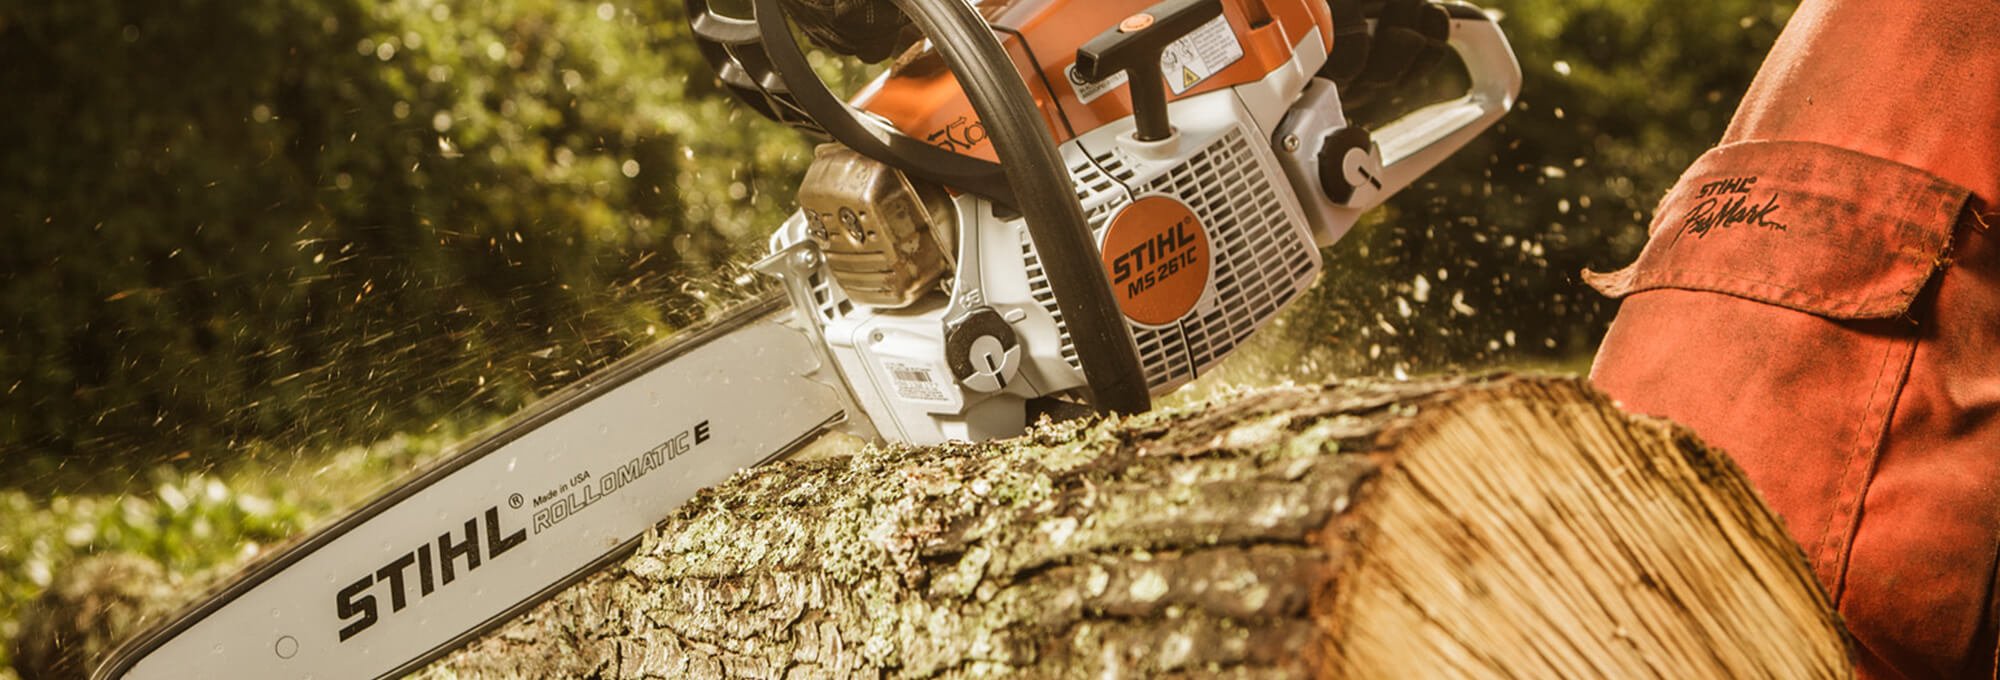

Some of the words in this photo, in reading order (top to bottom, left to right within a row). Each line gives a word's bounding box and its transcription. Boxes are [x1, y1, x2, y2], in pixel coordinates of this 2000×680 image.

[1128, 270, 1156, 299] MS
[532, 430, 690, 534] ROLLOMATIC
[694, 420, 711, 446] E
[532, 489, 558, 507] Made
[559, 482, 569, 494] in
[570, 470, 591, 487] USA
